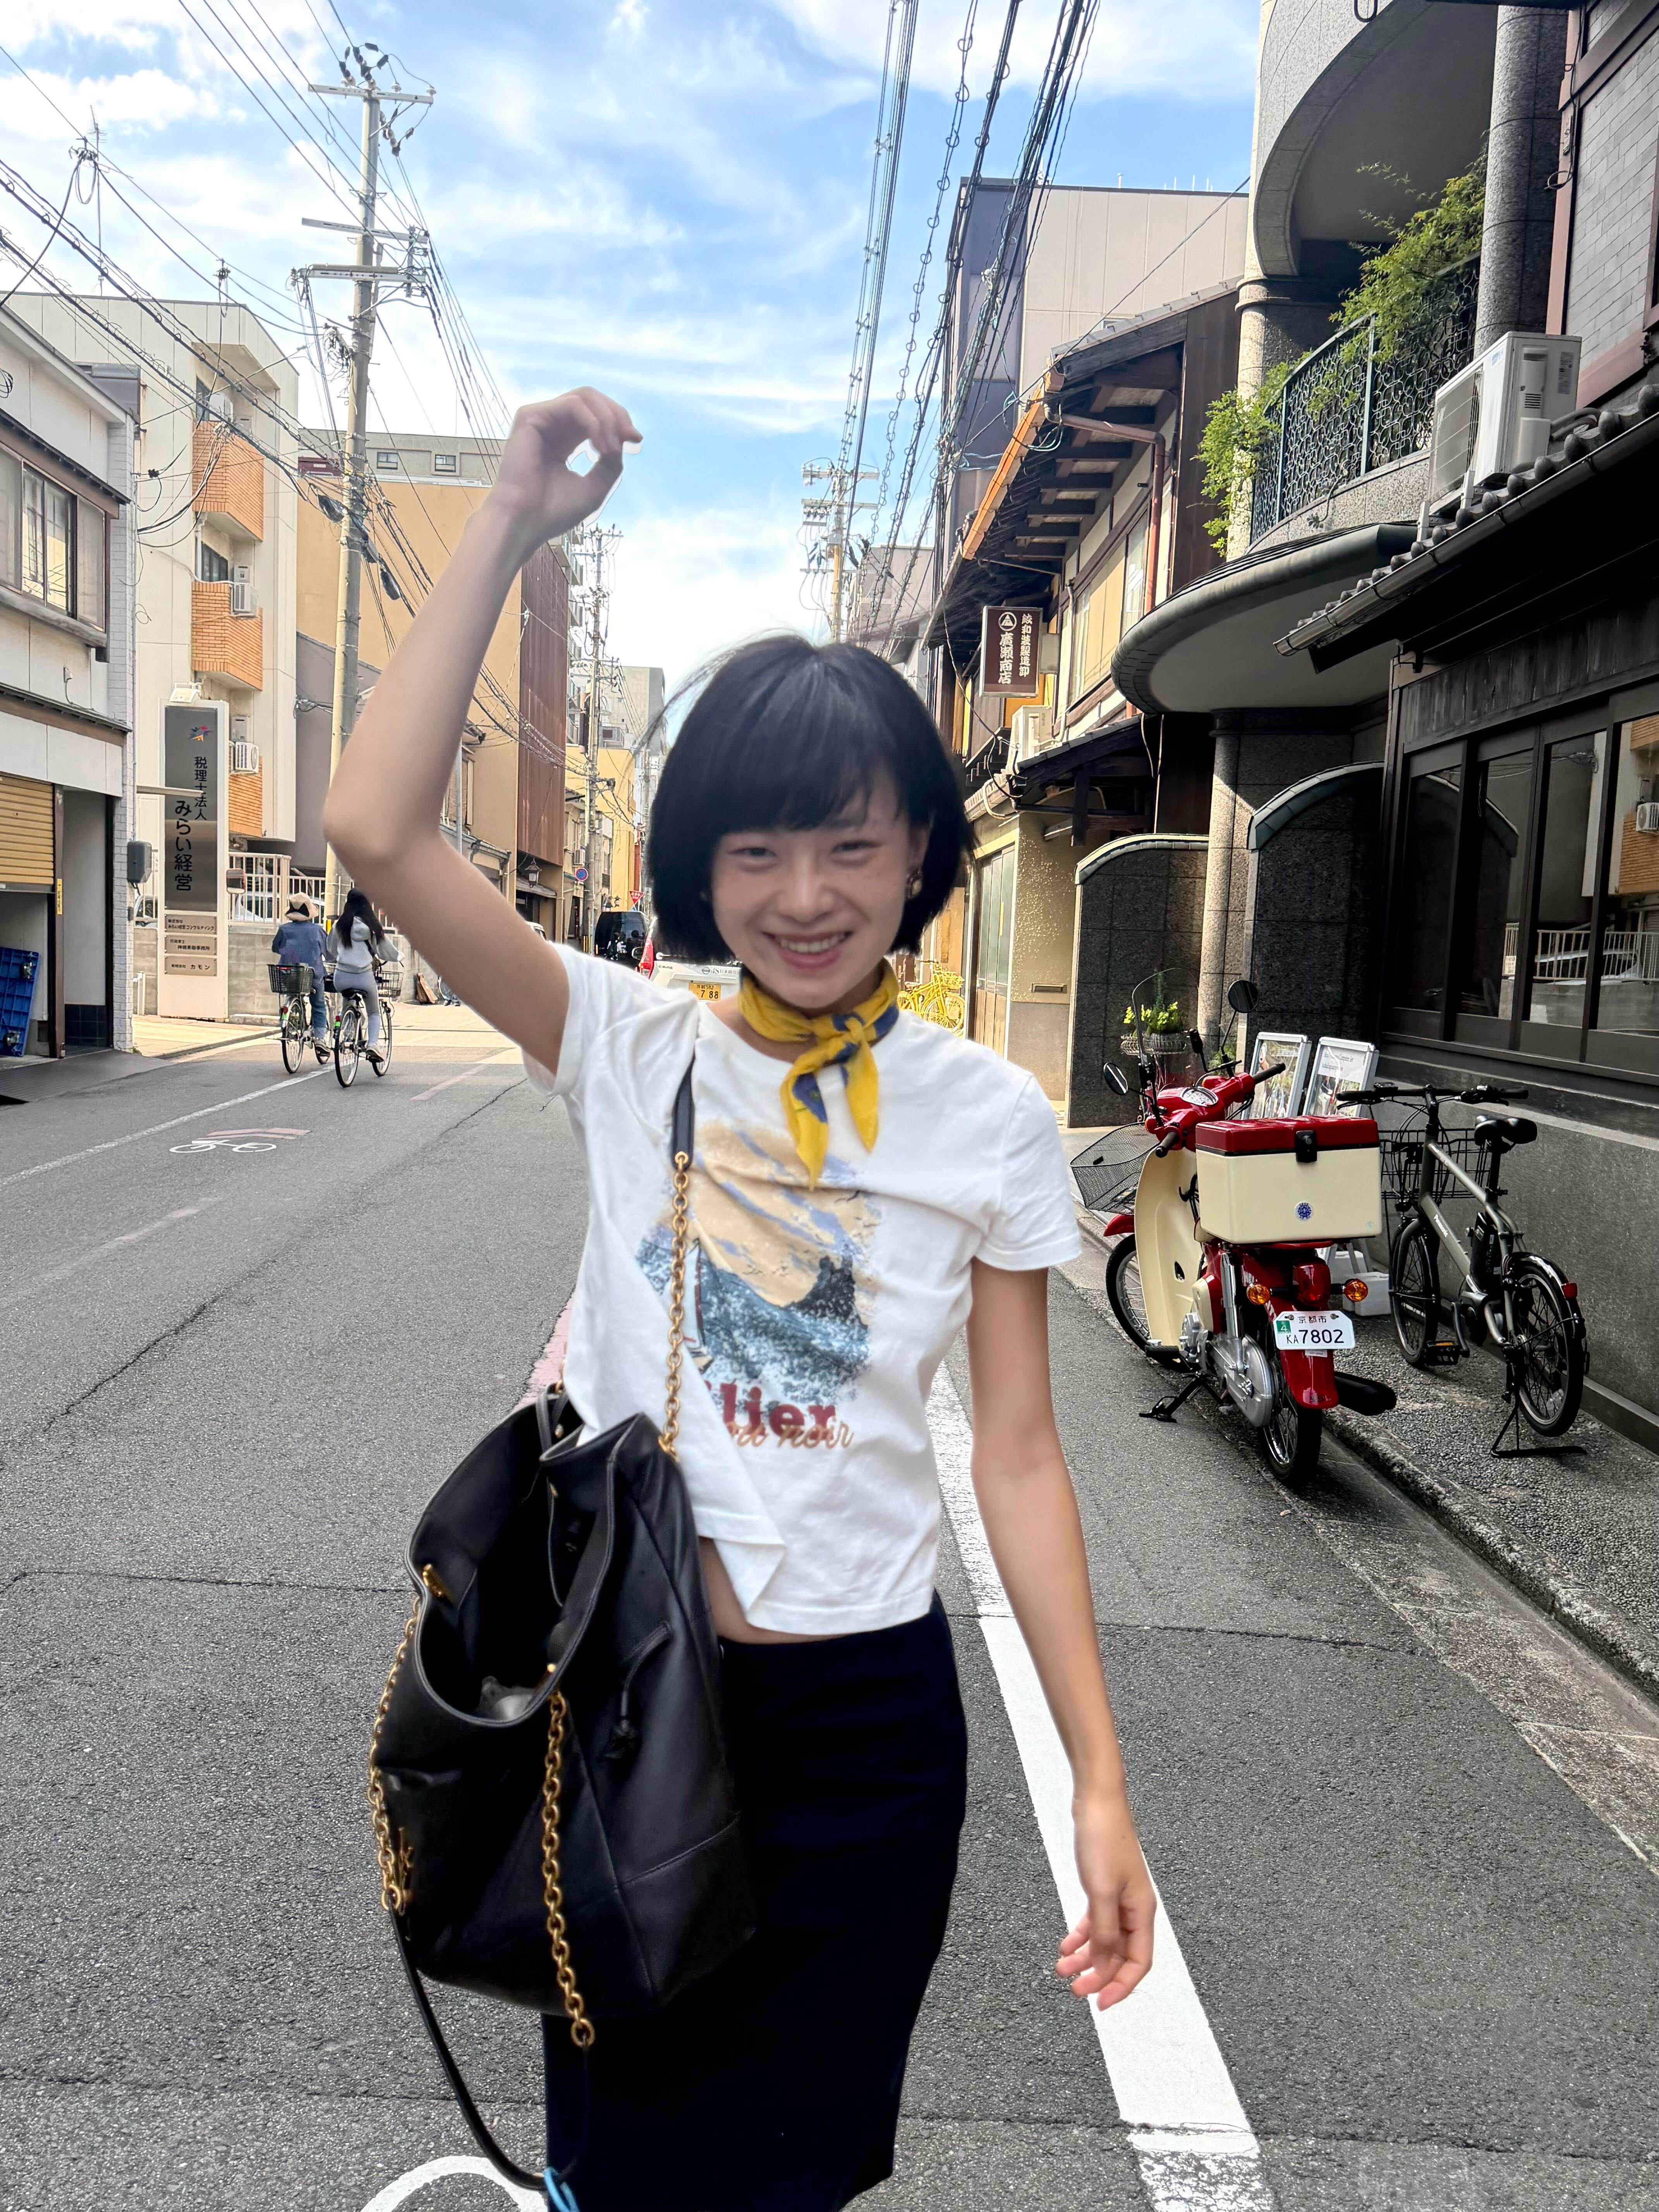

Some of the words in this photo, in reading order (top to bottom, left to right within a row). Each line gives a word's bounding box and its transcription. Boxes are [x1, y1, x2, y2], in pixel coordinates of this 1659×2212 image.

[194, 756, 207, 820] 税理士法人
[174, 800, 192, 891] みらい経営
[1286, 1334, 1299, 1344] KA
[1298, 1329, 1344, 1343] 7802
[704, 1380, 836, 1439] lier
